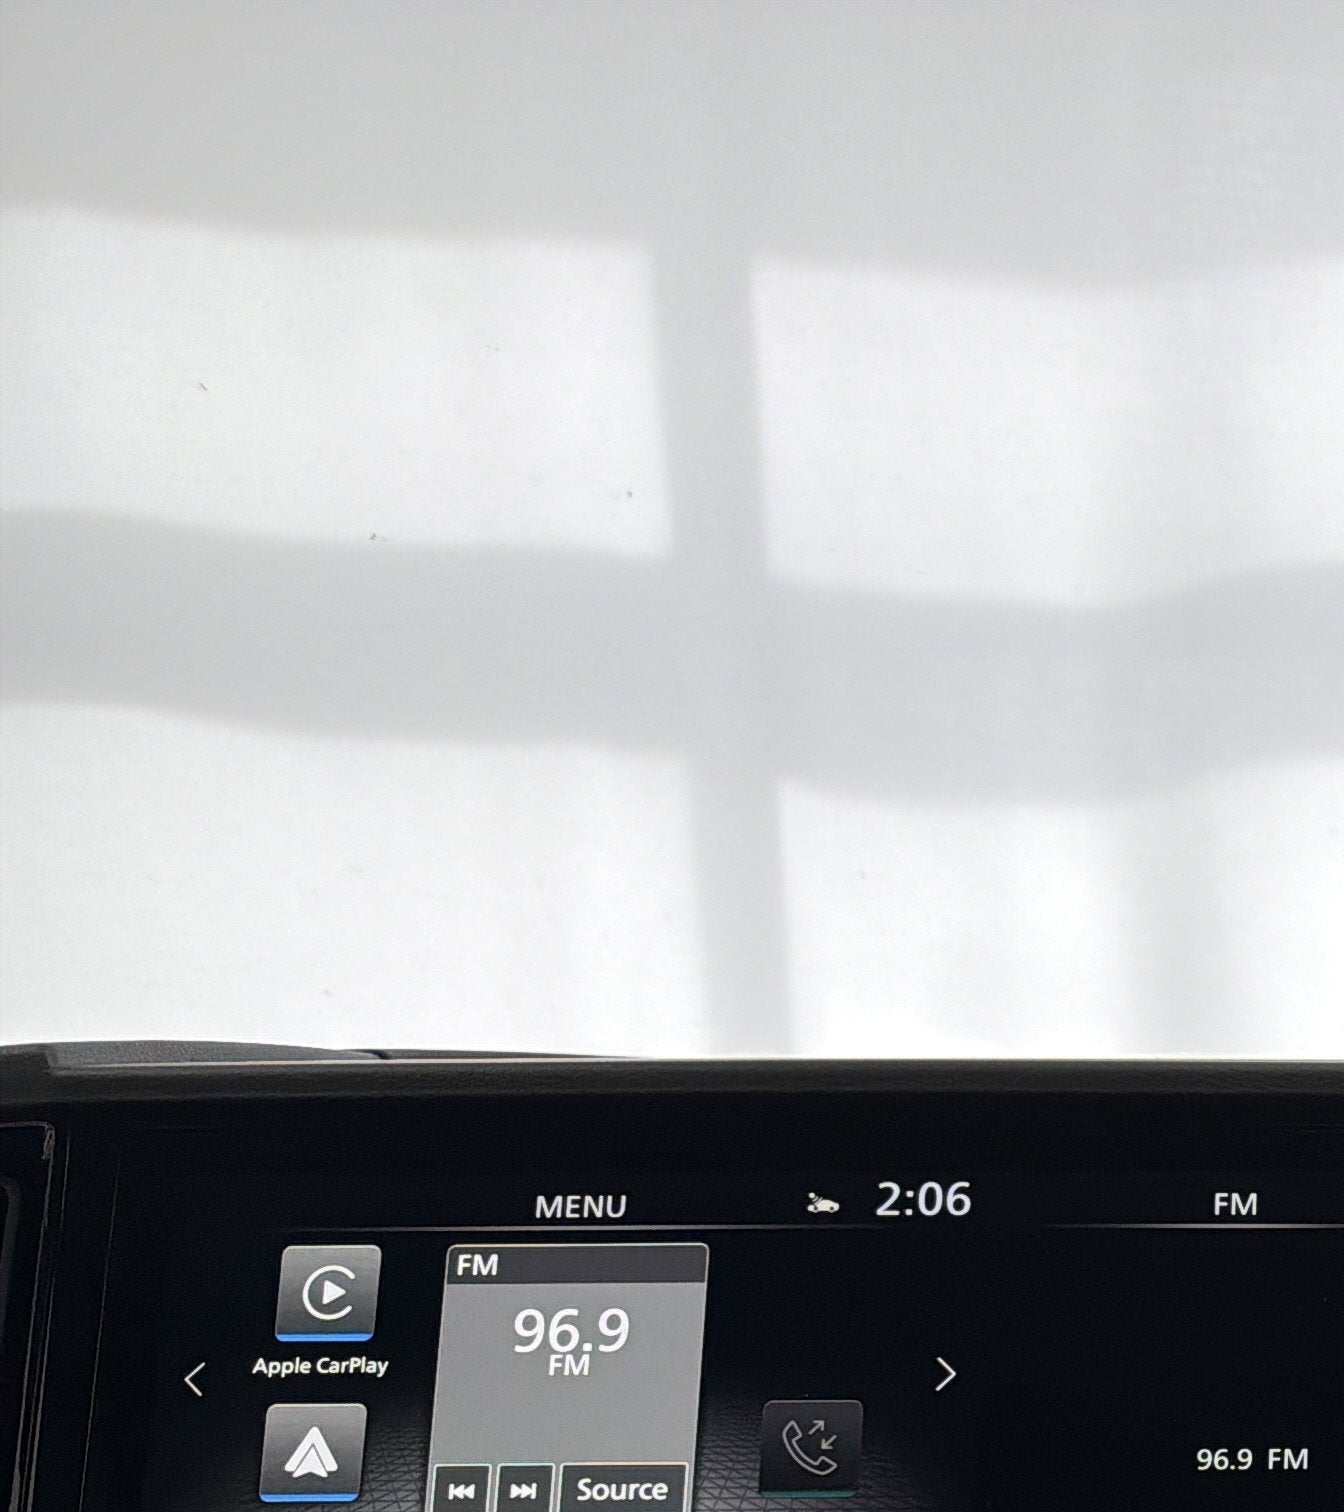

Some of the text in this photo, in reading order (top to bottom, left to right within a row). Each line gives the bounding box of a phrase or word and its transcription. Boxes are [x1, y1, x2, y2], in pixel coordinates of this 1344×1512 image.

[536, 1195, 626, 1218] MENU
[876, 1182, 971, 1216] 2:06
[1215, 1193, 1257, 1215] FM
[457, 1254, 498, 1275] FM
[515, 1308, 629, 1352] 96.9
[252, 1356, 388, 1377] Apple CarPlay
[549, 1354, 589, 1375] FM
[1197, 1448, 1308, 1470] 96.9 FM
[577, 1478, 668, 1500] Source
